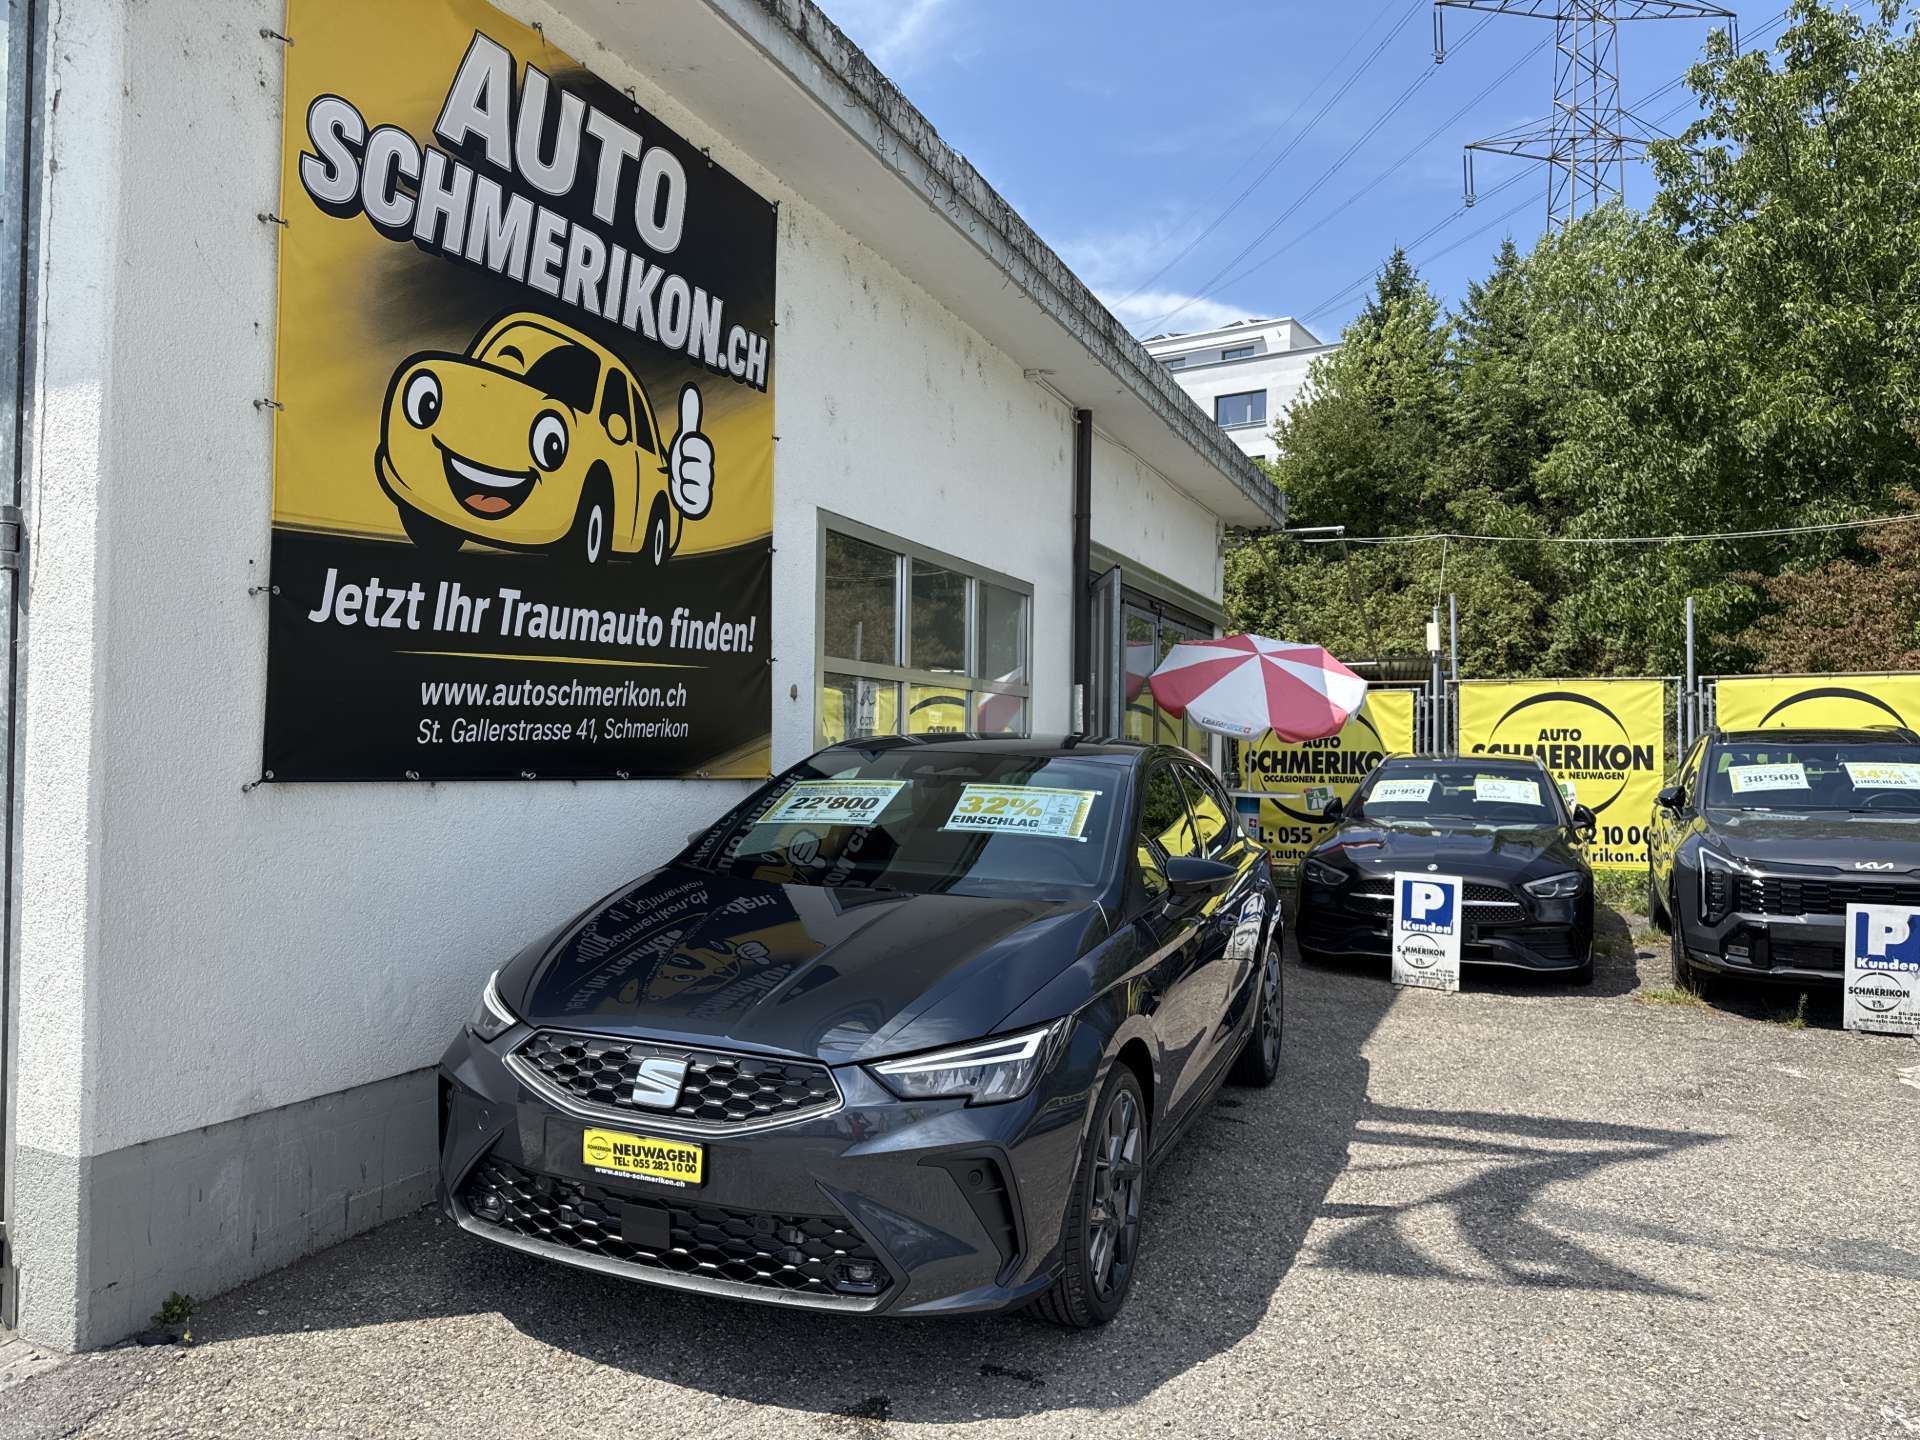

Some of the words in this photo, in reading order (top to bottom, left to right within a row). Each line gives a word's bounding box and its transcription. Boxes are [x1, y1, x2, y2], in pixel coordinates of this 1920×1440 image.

[436, 31, 688, 255] AUTO
[300, 96, 768, 389] SCHMERIKON.CH
[308, 568, 425, 630] Jetzt
[433, 580, 489, 633] Ihr
[498, 588, 664, 647] Traumauto
[669, 607, 756, 653] finden!
[420, 680, 688, 708] www.autoschmerikon.ch
[417, 718, 444, 744] St.
[450, 717, 571, 743] Gallerstrasse
[575, 718, 599, 744] 41,
[603, 718, 689, 741] Schmerikon
[1538, 728, 1582, 742] AUTO
[1302, 736, 1341, 749] AUTO
[1245, 750, 1391, 774] SCHMERIKO
[1263, 775, 1316, 784] OCCASIONEN
[1319, 776, 1326, 784] &
[1328, 776, 1366, 785] NEUWA
[1557, 771, 1565, 780] &
[1568, 771, 1625, 780] NEUWAGEN
[1743, 773, 1800, 785] 38'500
[788, 796, 880, 810] 22'800
[959, 795, 1042, 817] 32%
[950, 815, 1040, 828] EINSCHLAG
[1278, 827, 1313, 844] 055
[1602, 826, 1624, 846] 10
[1410, 882, 1445, 920] P
[1402, 920, 1452, 935] Kunden
[1867, 911, 1910, 956] P
[1856, 957, 1920, 971] Kunden
[1848, 986, 1911, 998] SCHMERIKON
[612, 1143, 697, 1164] NEUWAGEN
[613, 1156, 630, 1167] TEL:
[633, 1158, 650, 1169] 055
[652, 1160, 669, 1172] 282
[672, 1162, 683, 1173] 10
[685, 1163, 697, 1174] 00
[594, 1167, 686, 1188] www.auto-schmerikon.ch
